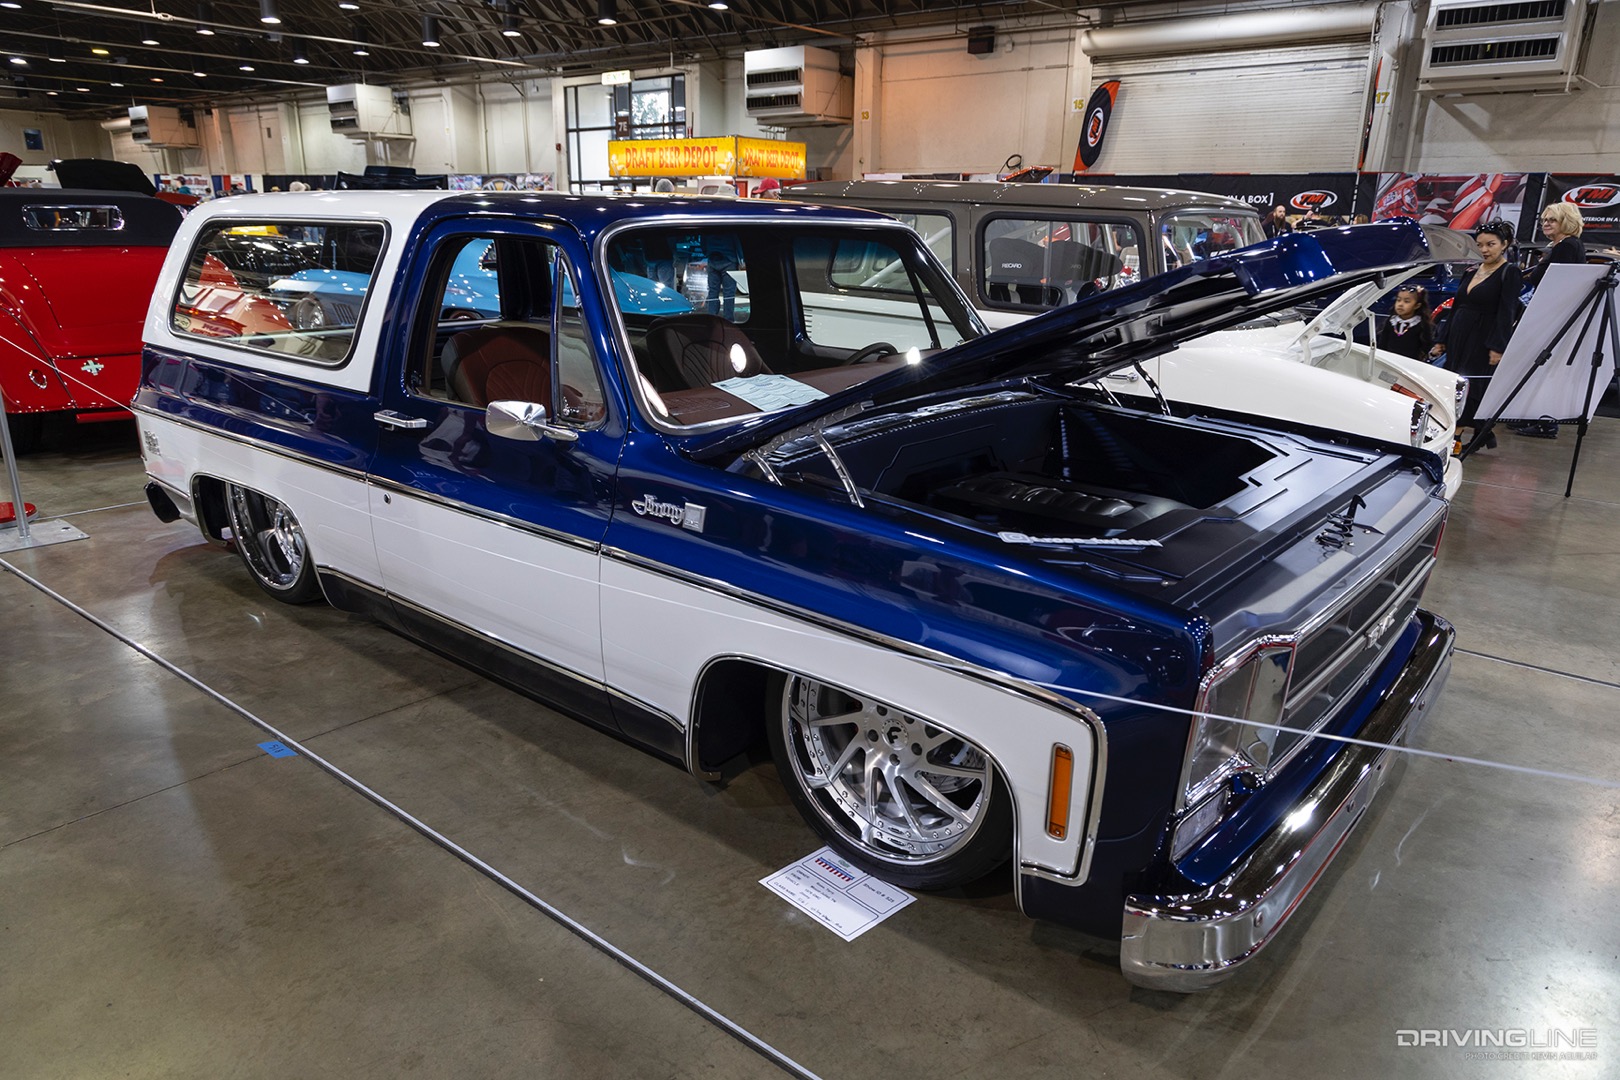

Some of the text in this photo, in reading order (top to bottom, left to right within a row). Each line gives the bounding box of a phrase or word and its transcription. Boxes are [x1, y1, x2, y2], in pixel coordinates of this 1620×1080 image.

[1073, 99, 1084, 110] 15
[1376, 91, 1390, 104] 17
[618, 121, 628, 131] 7E
[625, 145, 718, 169] DRAFT BEER DEPOT
[745, 147, 799, 169] DRAFT BEER DEPOT
[1299, 193, 1327, 205] TMI
[1575, 188, 1617, 203] TMI
[632, 494, 686, 525] Jimmy
